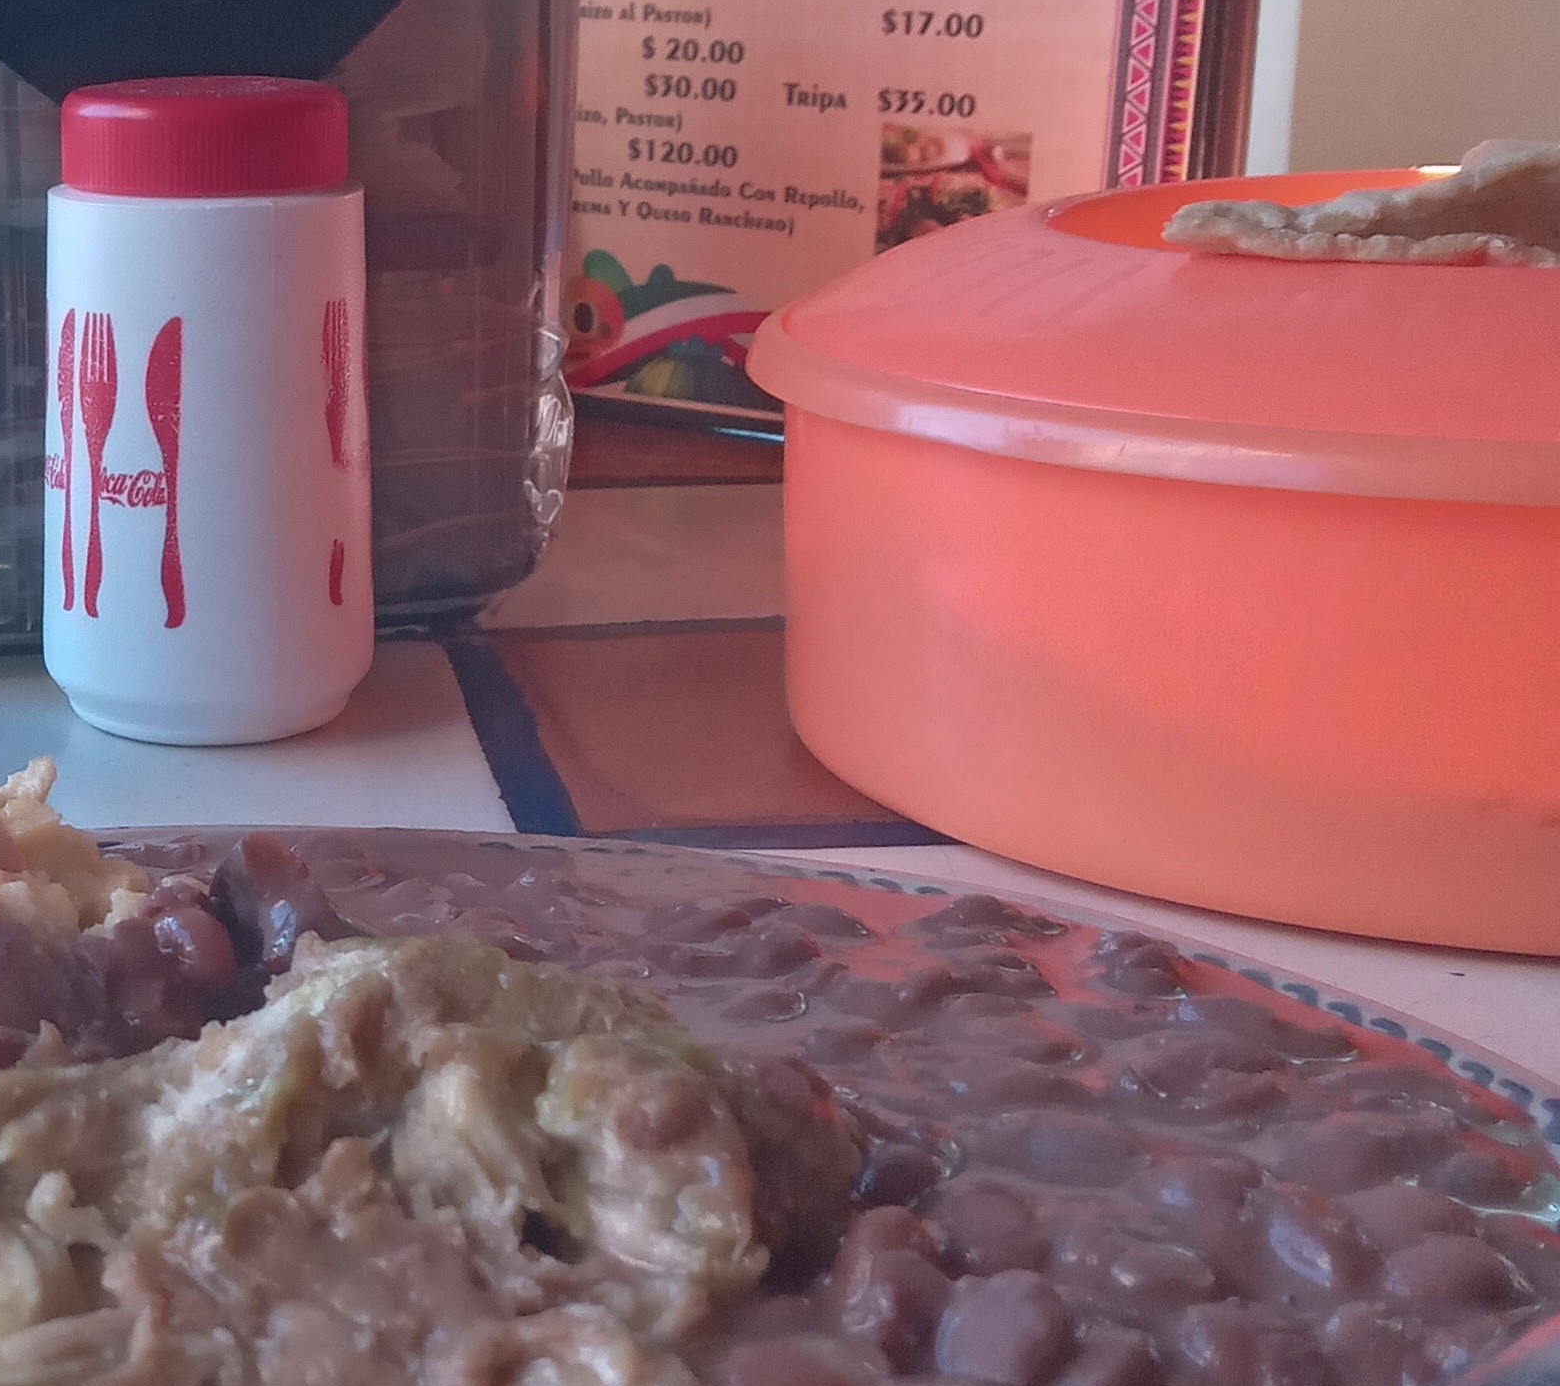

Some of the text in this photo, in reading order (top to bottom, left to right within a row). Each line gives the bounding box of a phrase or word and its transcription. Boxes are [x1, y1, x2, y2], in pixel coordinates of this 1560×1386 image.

[882, 9, 984, 39] $17.00
[645, 72, 737, 103] $30.00
[878, 87, 976, 118] $35.00
[628, 137, 739, 169] $120.00
